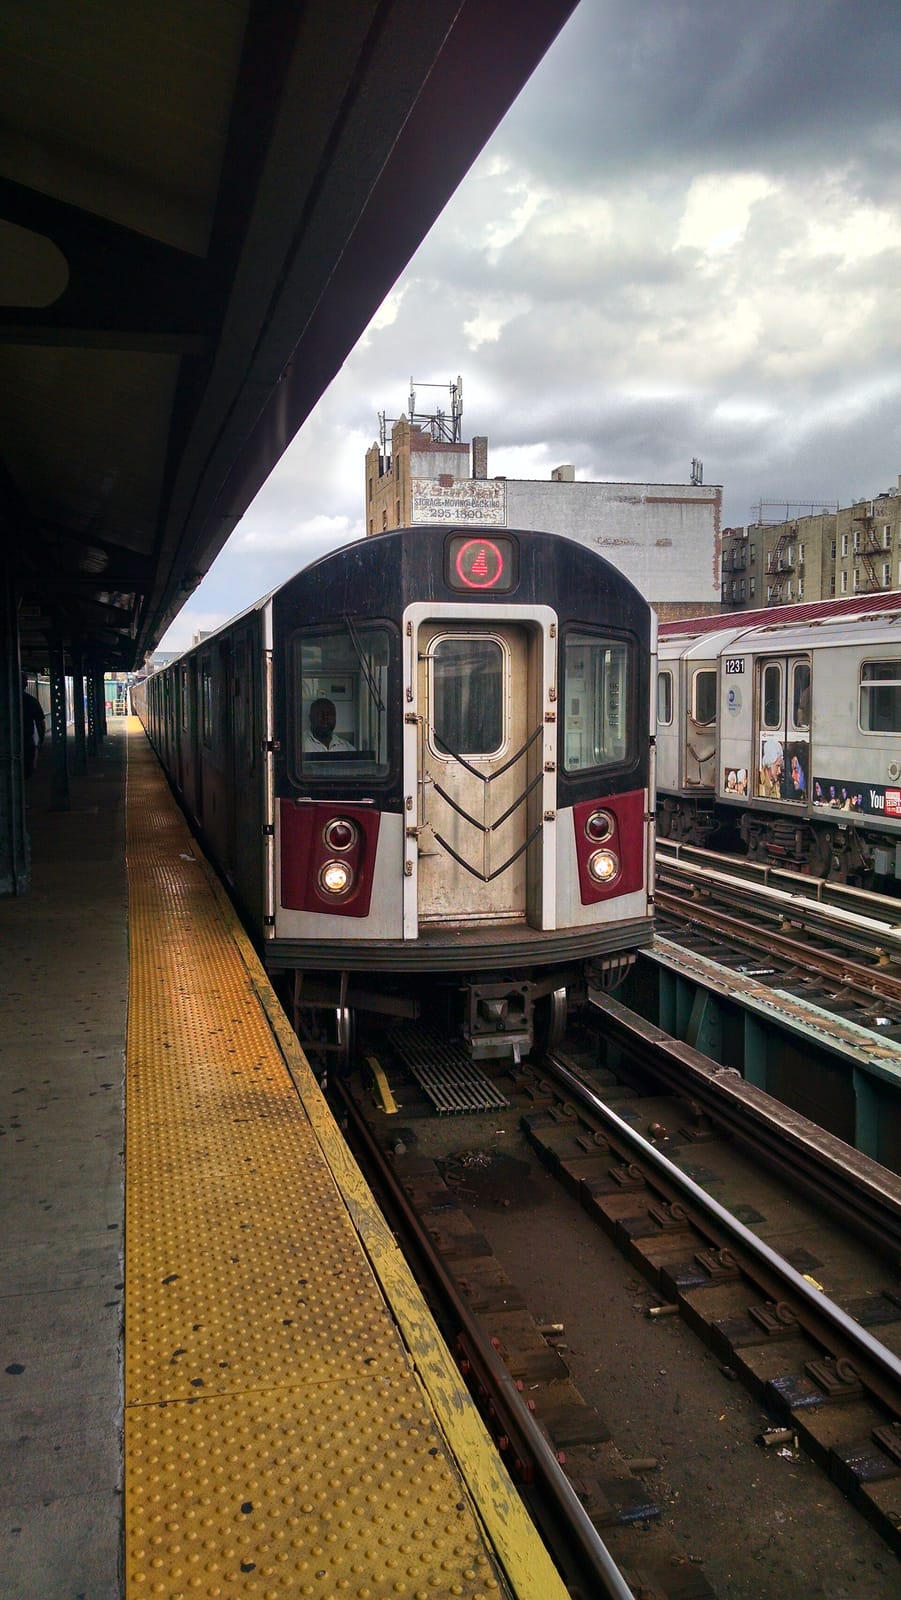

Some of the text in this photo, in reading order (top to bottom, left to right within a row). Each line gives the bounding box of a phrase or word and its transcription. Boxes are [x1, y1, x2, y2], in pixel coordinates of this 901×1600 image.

[471, 549, 488, 576] 4
[727, 660, 744, 673] 1231
[870, 789, 884, 809] You
